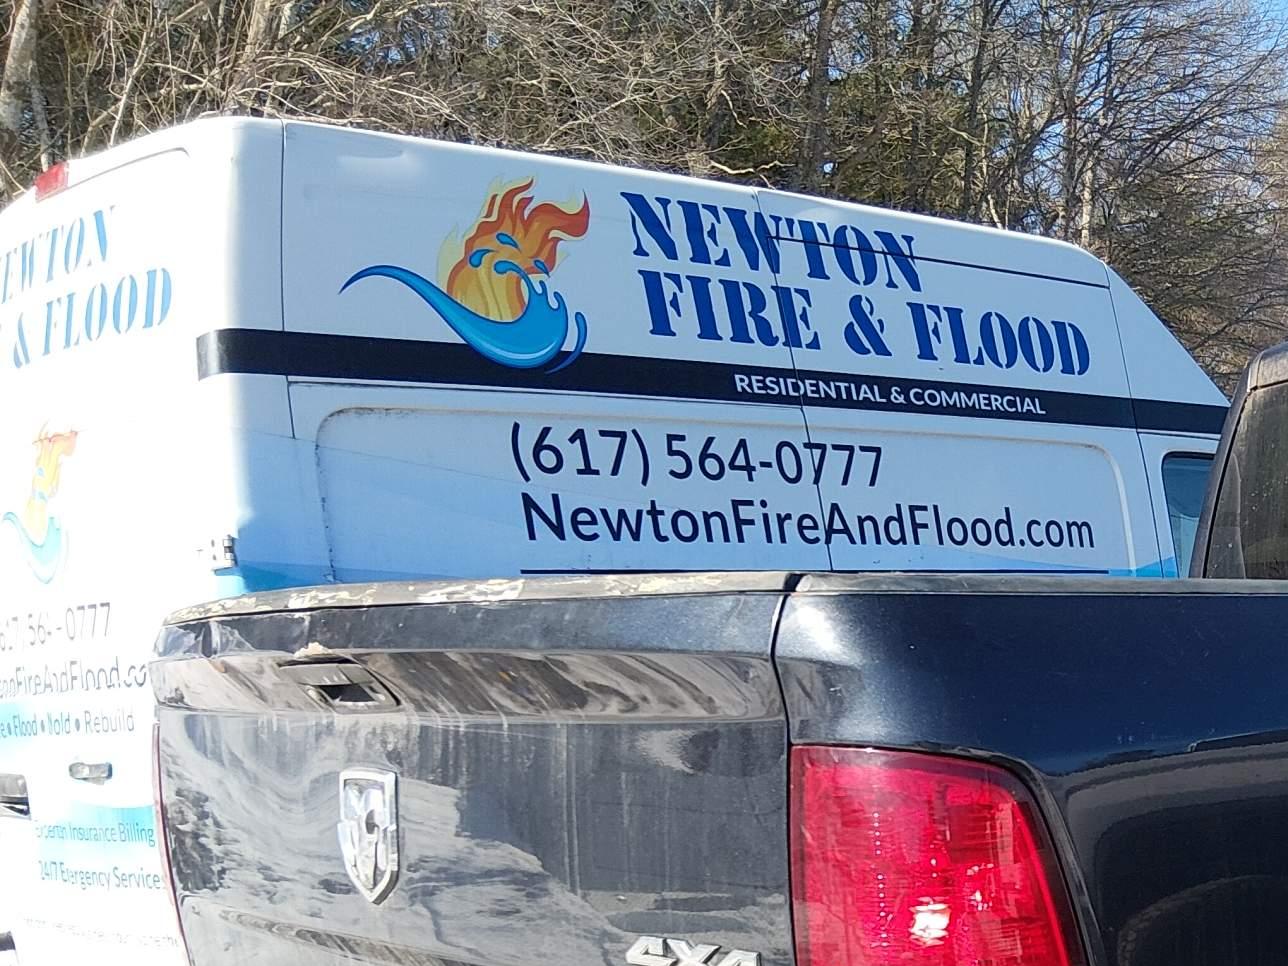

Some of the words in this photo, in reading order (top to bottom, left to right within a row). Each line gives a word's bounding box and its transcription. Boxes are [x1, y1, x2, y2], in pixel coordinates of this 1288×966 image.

[620, 191, 922, 293] NEWTON
[42, 267, 173, 357] FLOOD
[637, 269, 822, 351] FIRE
[844, 294, 893, 357] &
[906, 301, 1091, 377] FLOOD
[734, 373, 887, 404] RESIDENTIAL
[889, 385, 907, 404] &
[908, 388, 1047, 415] COMMERCIAL
[511, 421, 650, 488] (617)
[665, 432, 883, 488] 564-0777
[520, 492, 1096, 549] NewtonFireAndFlood.com
[84, 706, 135, 734] Rebuild
[68, 822, 118, 843] Insurance
[118, 821, 156, 848] Billing
